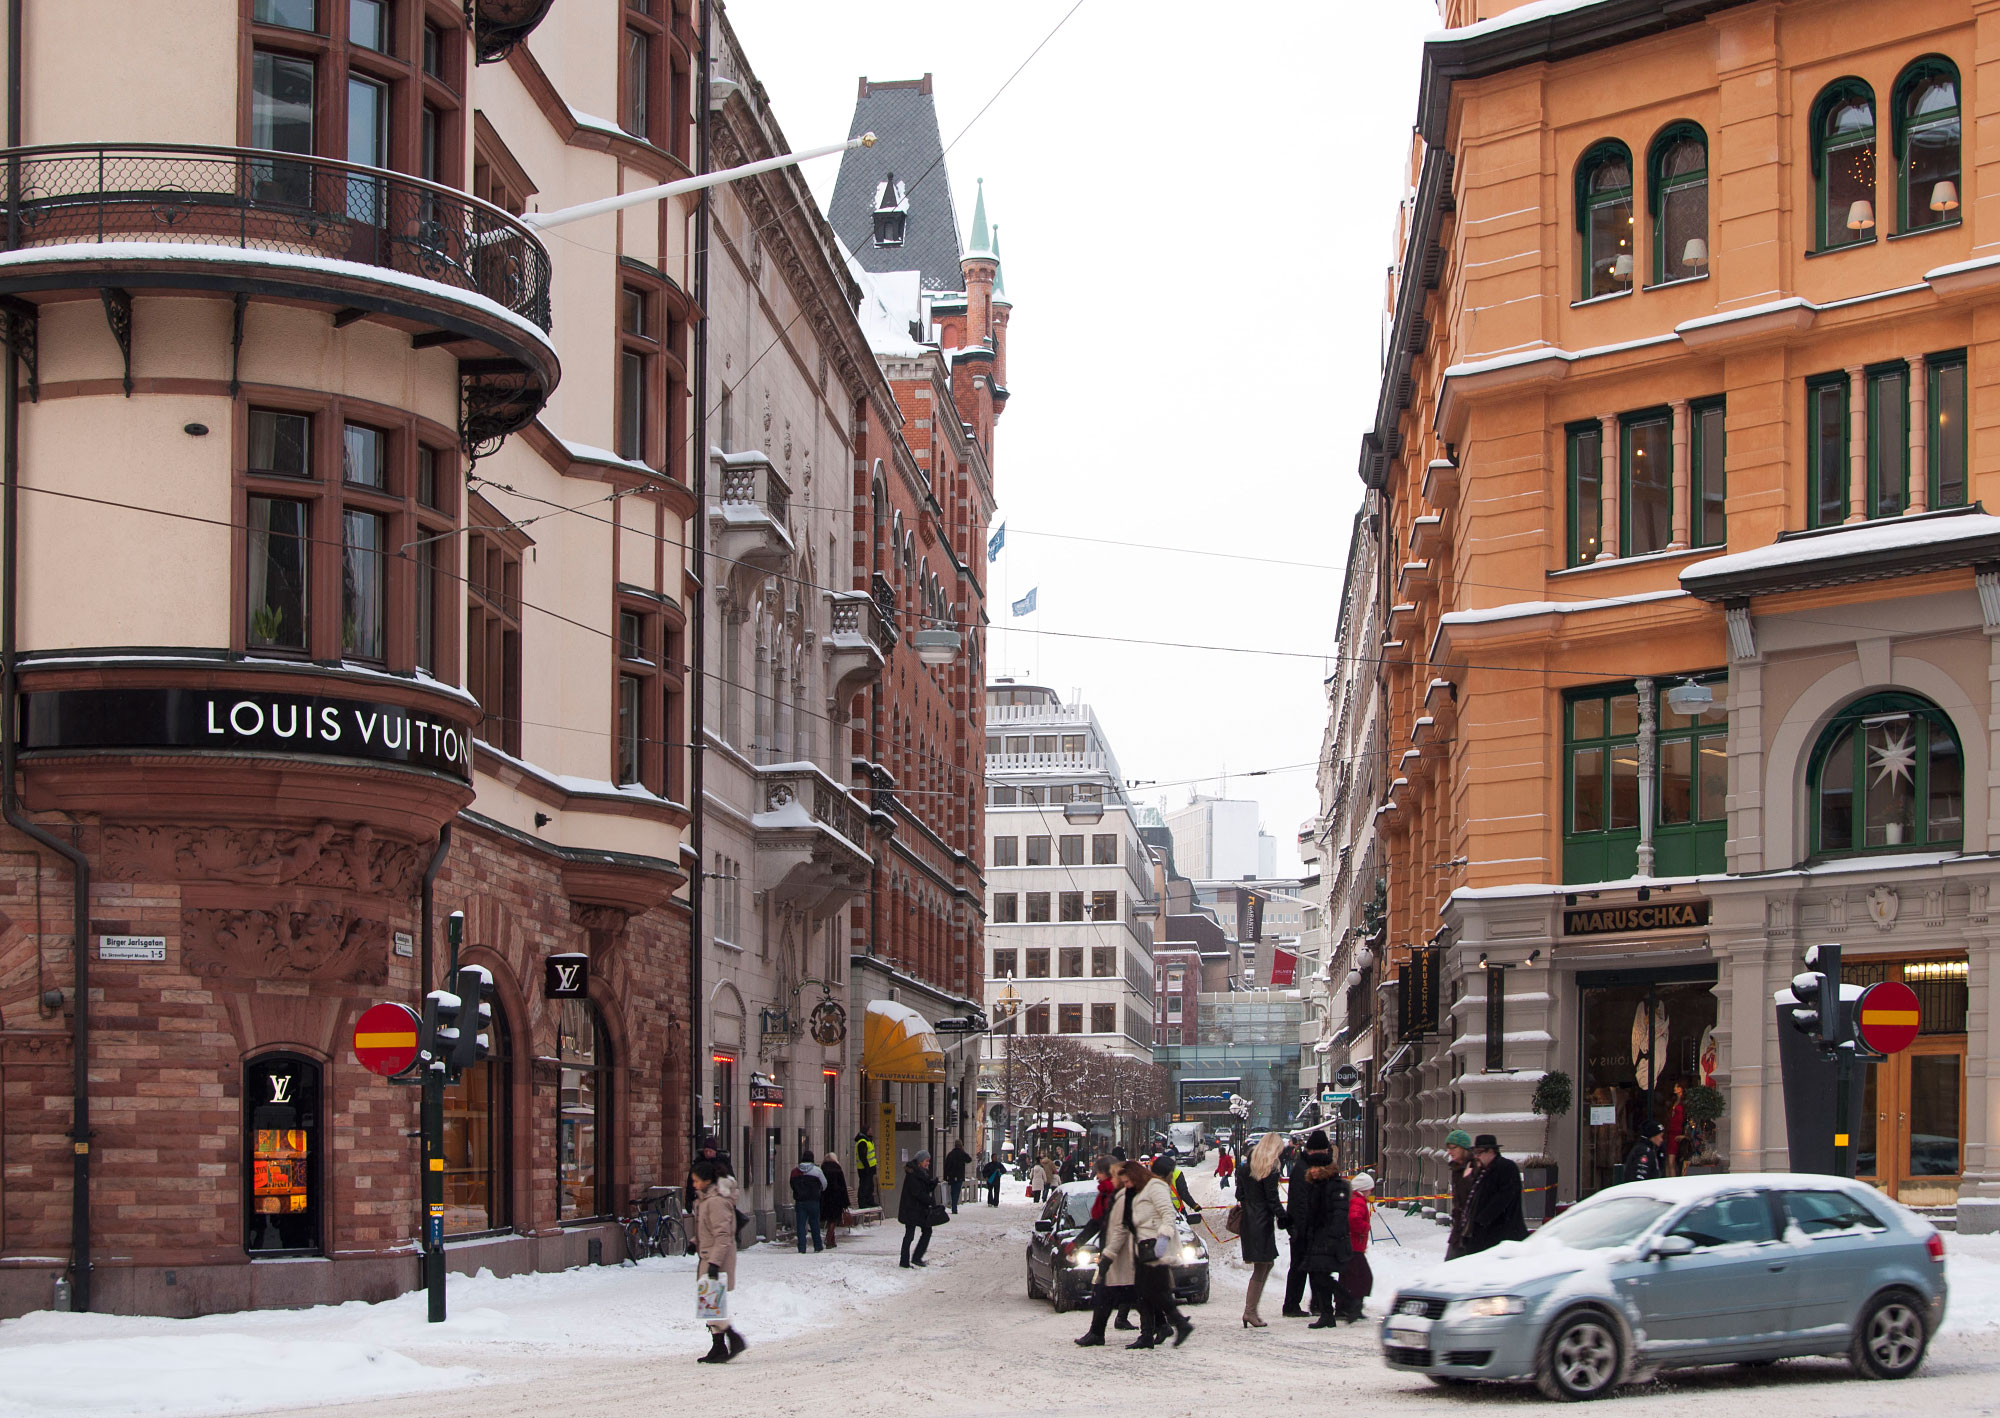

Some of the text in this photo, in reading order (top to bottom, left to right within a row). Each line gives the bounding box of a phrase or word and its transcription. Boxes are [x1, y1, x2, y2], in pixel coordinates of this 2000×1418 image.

[207, 700, 468, 764] LOUIS VUITTON
[1570, 905, 1698, 932] MARUSCHKA
[106, 938, 163, 947] Birger Jarlsgatan
[151, 950, 163, 958] 1-5
[1421, 952, 1429, 1015] MARUSCHKA
[1337, 1072, 1357, 1080] bank
[751, 1087, 765, 1098] KB
